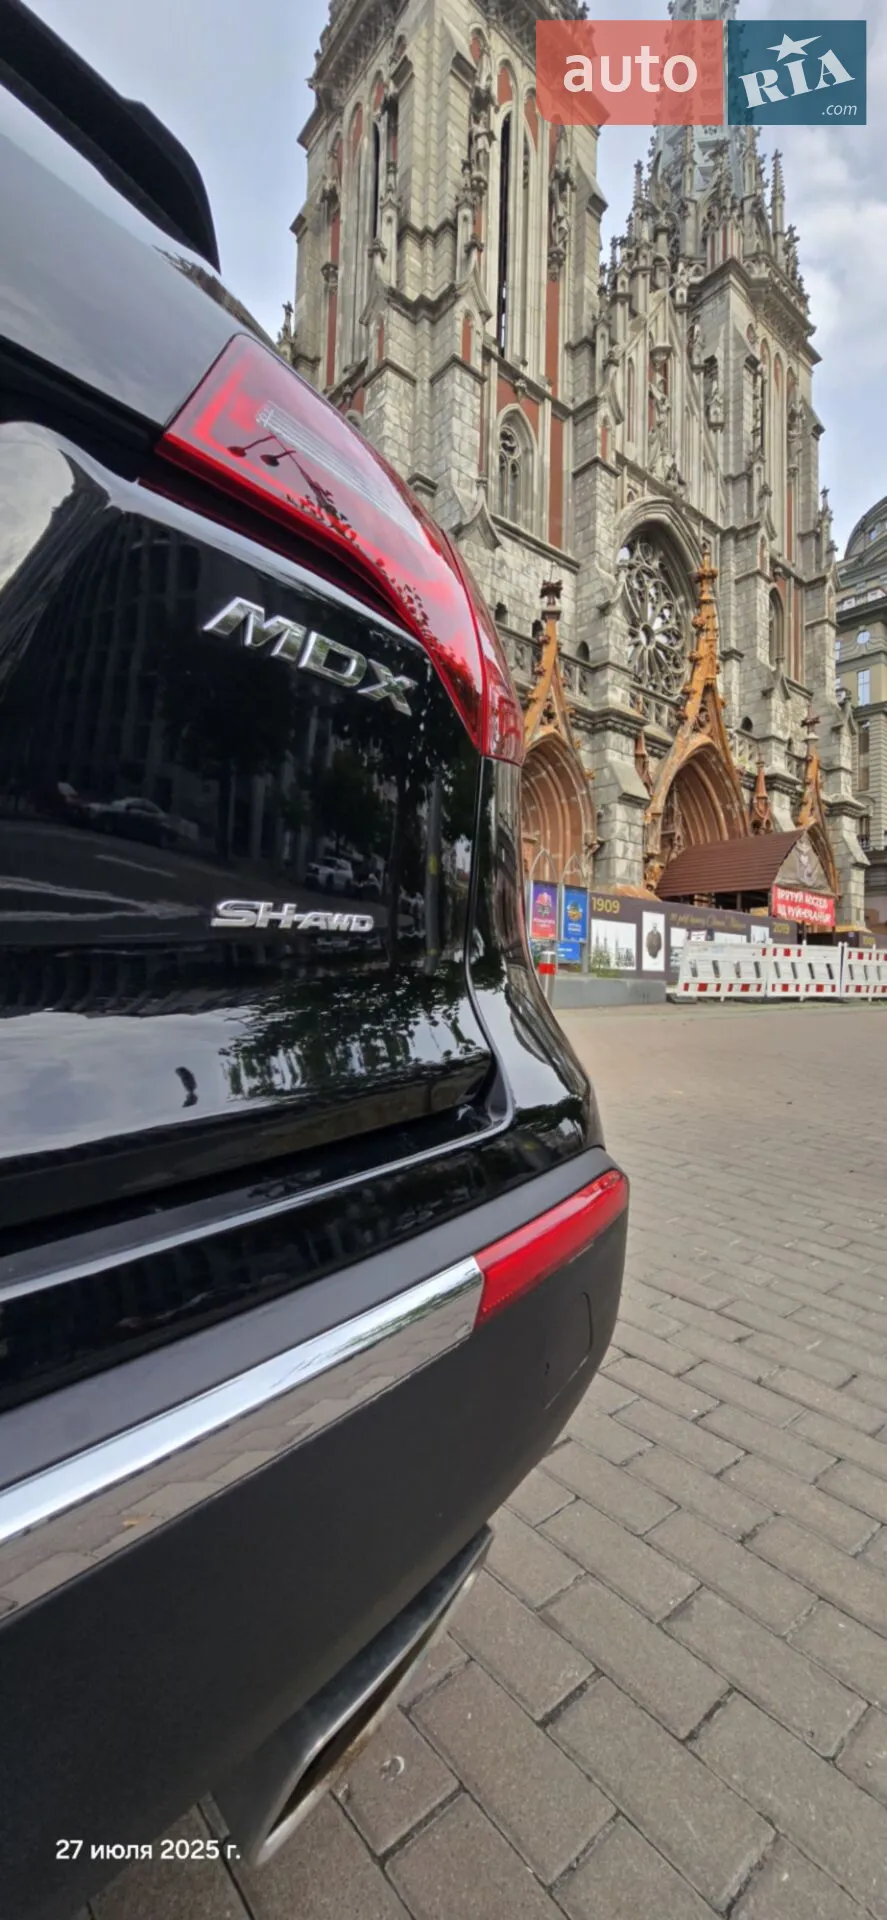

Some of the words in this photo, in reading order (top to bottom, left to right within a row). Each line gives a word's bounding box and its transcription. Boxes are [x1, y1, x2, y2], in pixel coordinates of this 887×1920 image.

[203, 596, 418, 716] MDX
[211, 900, 374, 932] SH-AWD
[591, 896, 620, 914] 1909
